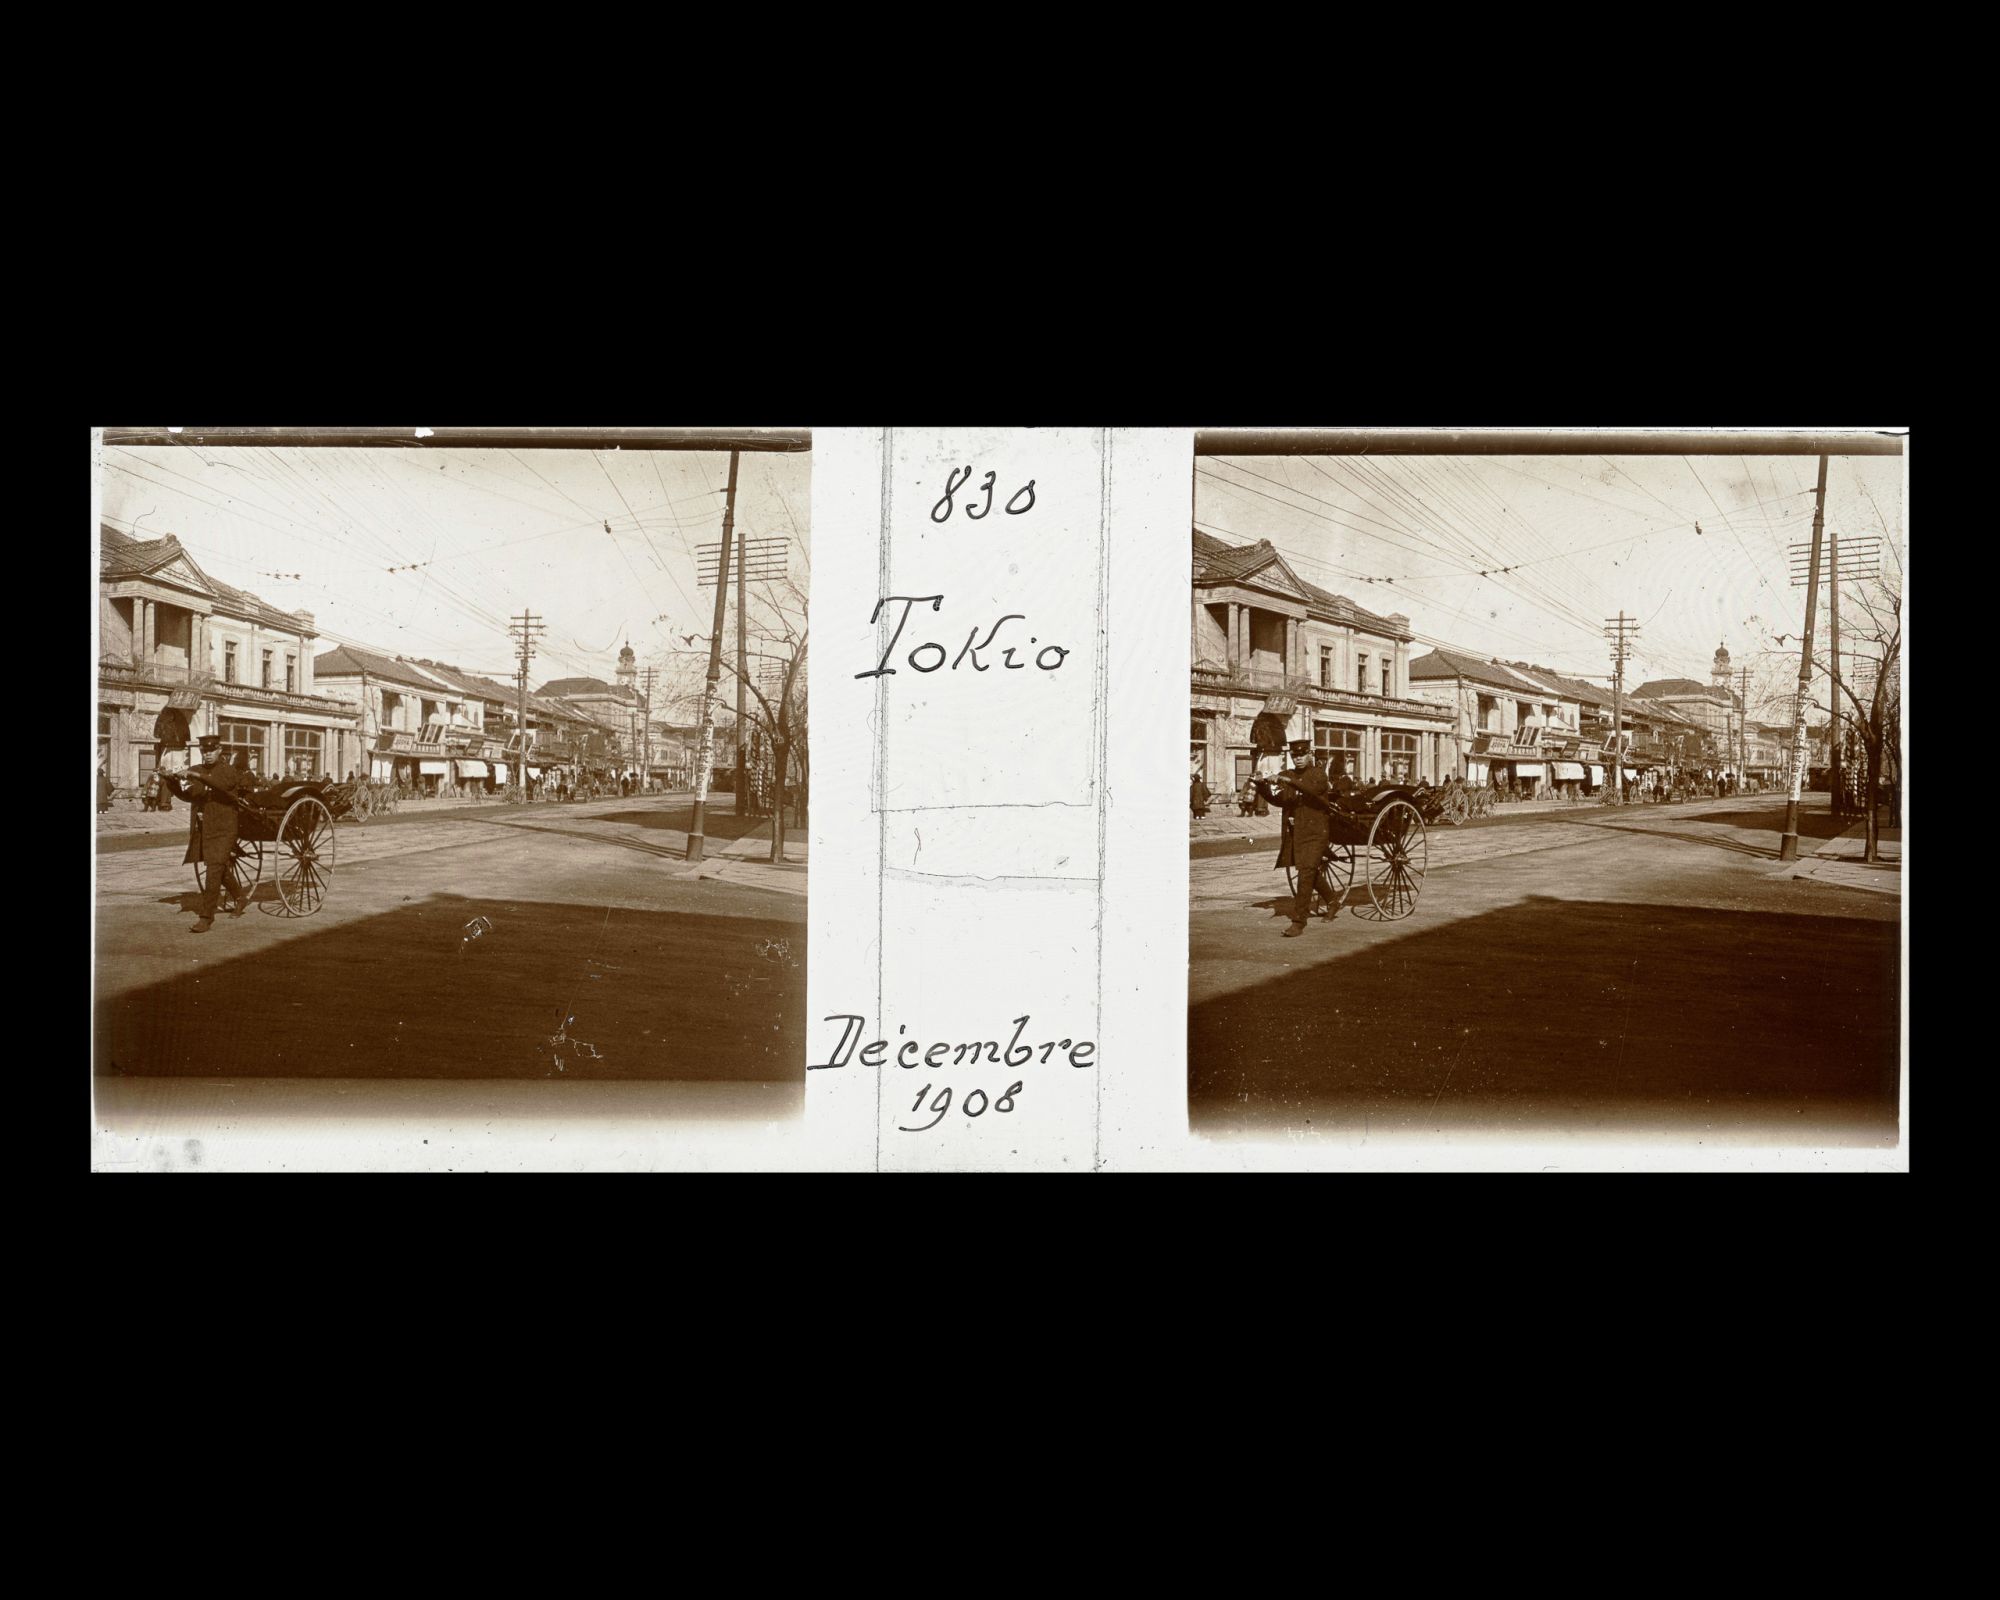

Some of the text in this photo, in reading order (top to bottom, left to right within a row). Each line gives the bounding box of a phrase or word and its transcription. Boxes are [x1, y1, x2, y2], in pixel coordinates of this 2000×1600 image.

[930, 465, 1036, 524] 830
[806, 1014, 1097, 1071] Décembre
[898, 1080, 1024, 1132] 1908
